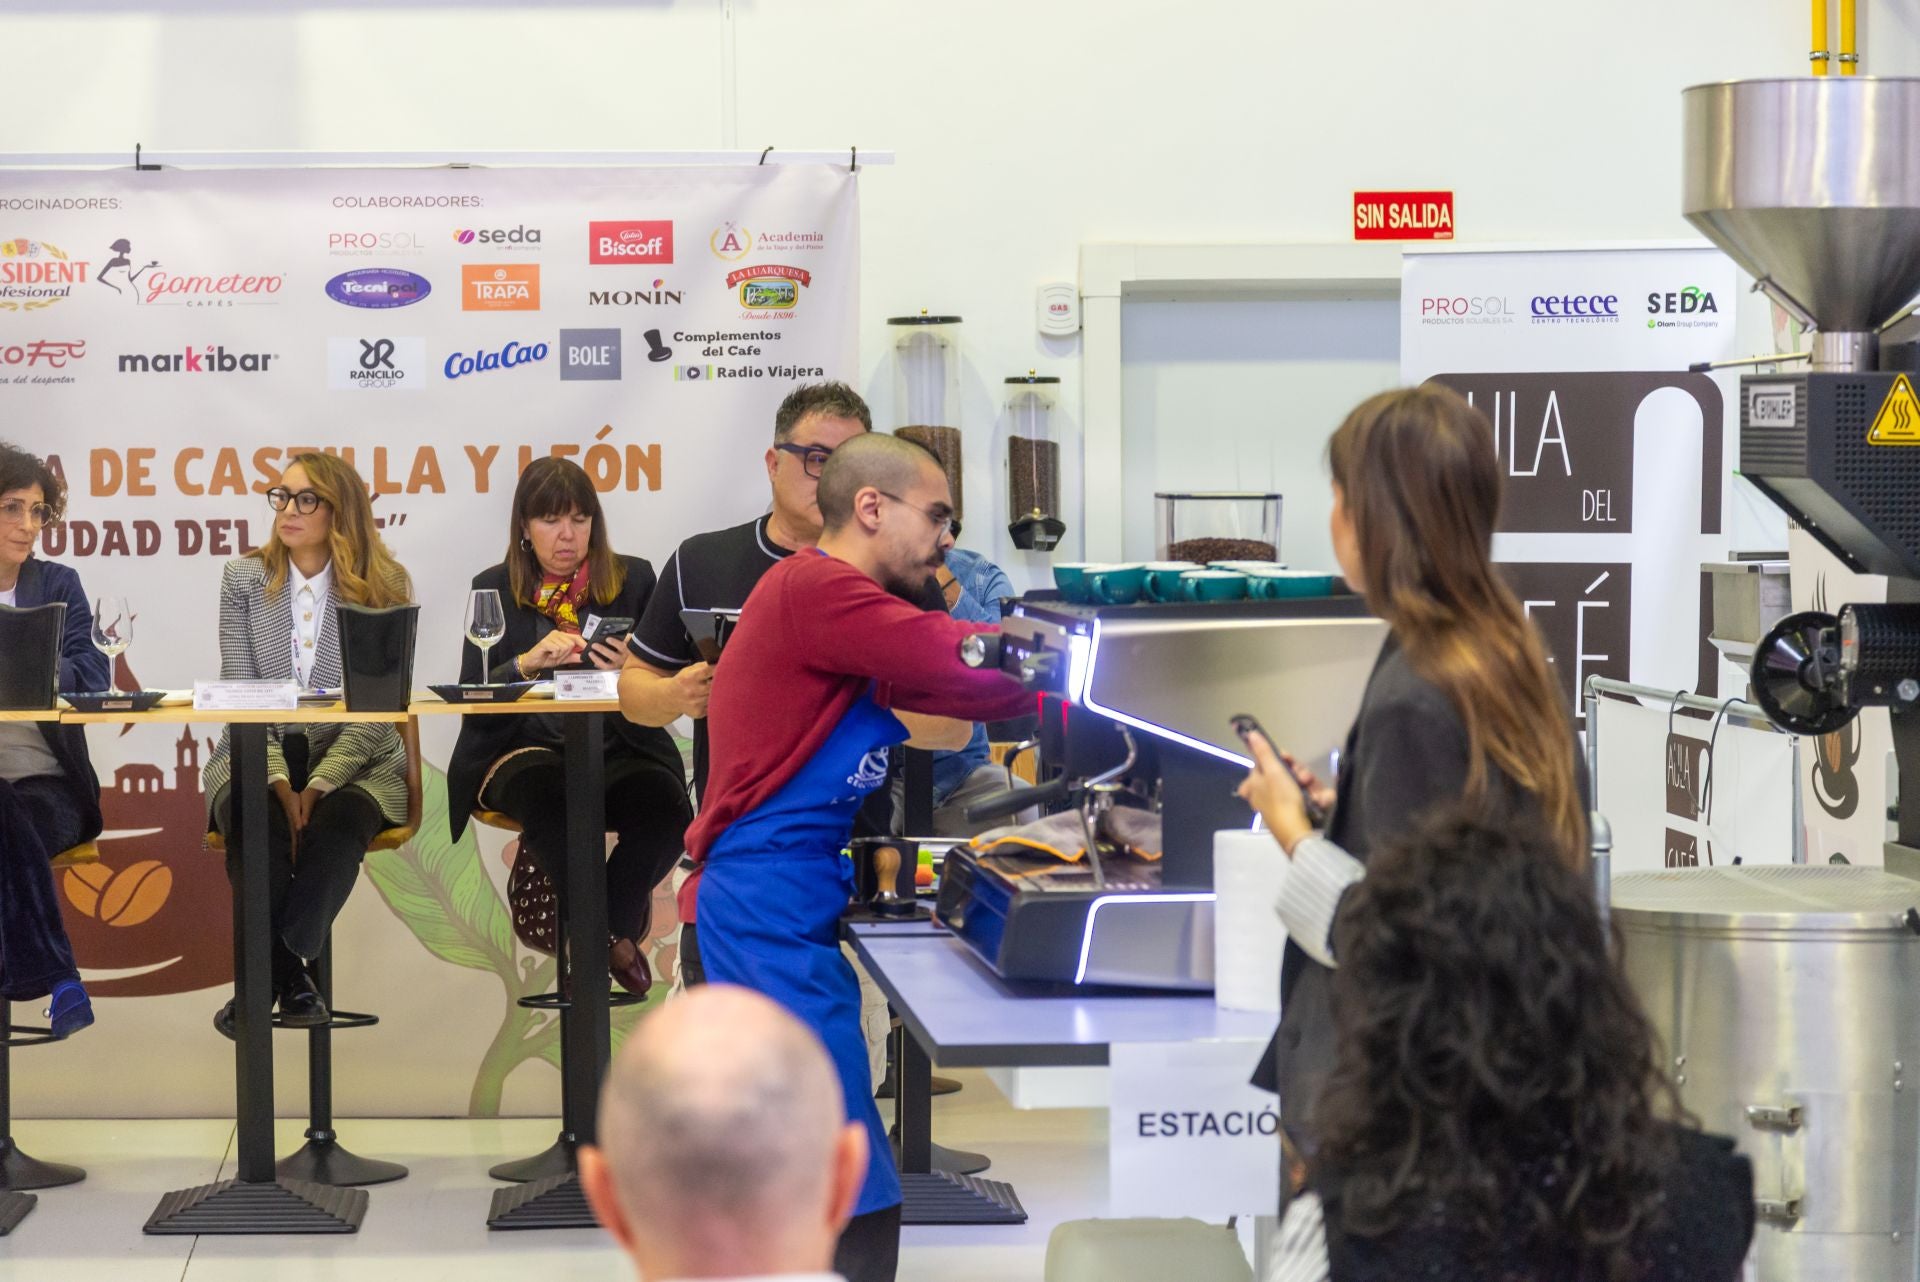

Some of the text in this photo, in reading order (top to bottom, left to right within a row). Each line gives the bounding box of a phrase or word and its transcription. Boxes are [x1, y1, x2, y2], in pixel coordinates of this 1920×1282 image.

[332, 196, 484, 208] COLABORADORES:
[1356, 203, 1452, 229] SIN SALIDA
[329, 233, 424, 248] PROSOL
[478, 225, 541, 243] seda
[758, 232, 823, 242] Academia
[601, 237, 663, 256] Biscoff
[0, 261, 90, 284] SIDENT
[732, 266, 805, 281] LA LUARQUESA
[472, 281, 529, 299] TRAPA
[589, 289, 682, 306] MONIN
[1050, 304, 1069, 312] GAS
[1422, 297, 1515, 316] PROSOL
[1531, 294, 1618, 315] cetece
[1647, 292, 1718, 314] SEDA
[1657, 320, 1676, 328] Olam
[673, 330, 782, 344] Complementos
[118, 345, 272, 373] markibar
[444, 341, 548, 379] ColaCao
[569, 346, 610, 366] BOLE
[702, 345, 761, 357] del Cafe
[13, 376, 28, 385] del
[31, 376, 76, 387] despertar
[350, 370, 404, 379] RANCILIO
[717, 366, 824, 380] Radio Viajera
[359, 380, 396, 388] GROUP
[90, 447, 156, 497] DE
[174, 445, 446, 496] CASLA
[464, 444, 500, 494] Y
[1582, 489, 1617, 522] DEL
[32, 518, 260, 556] UDAD DEL
